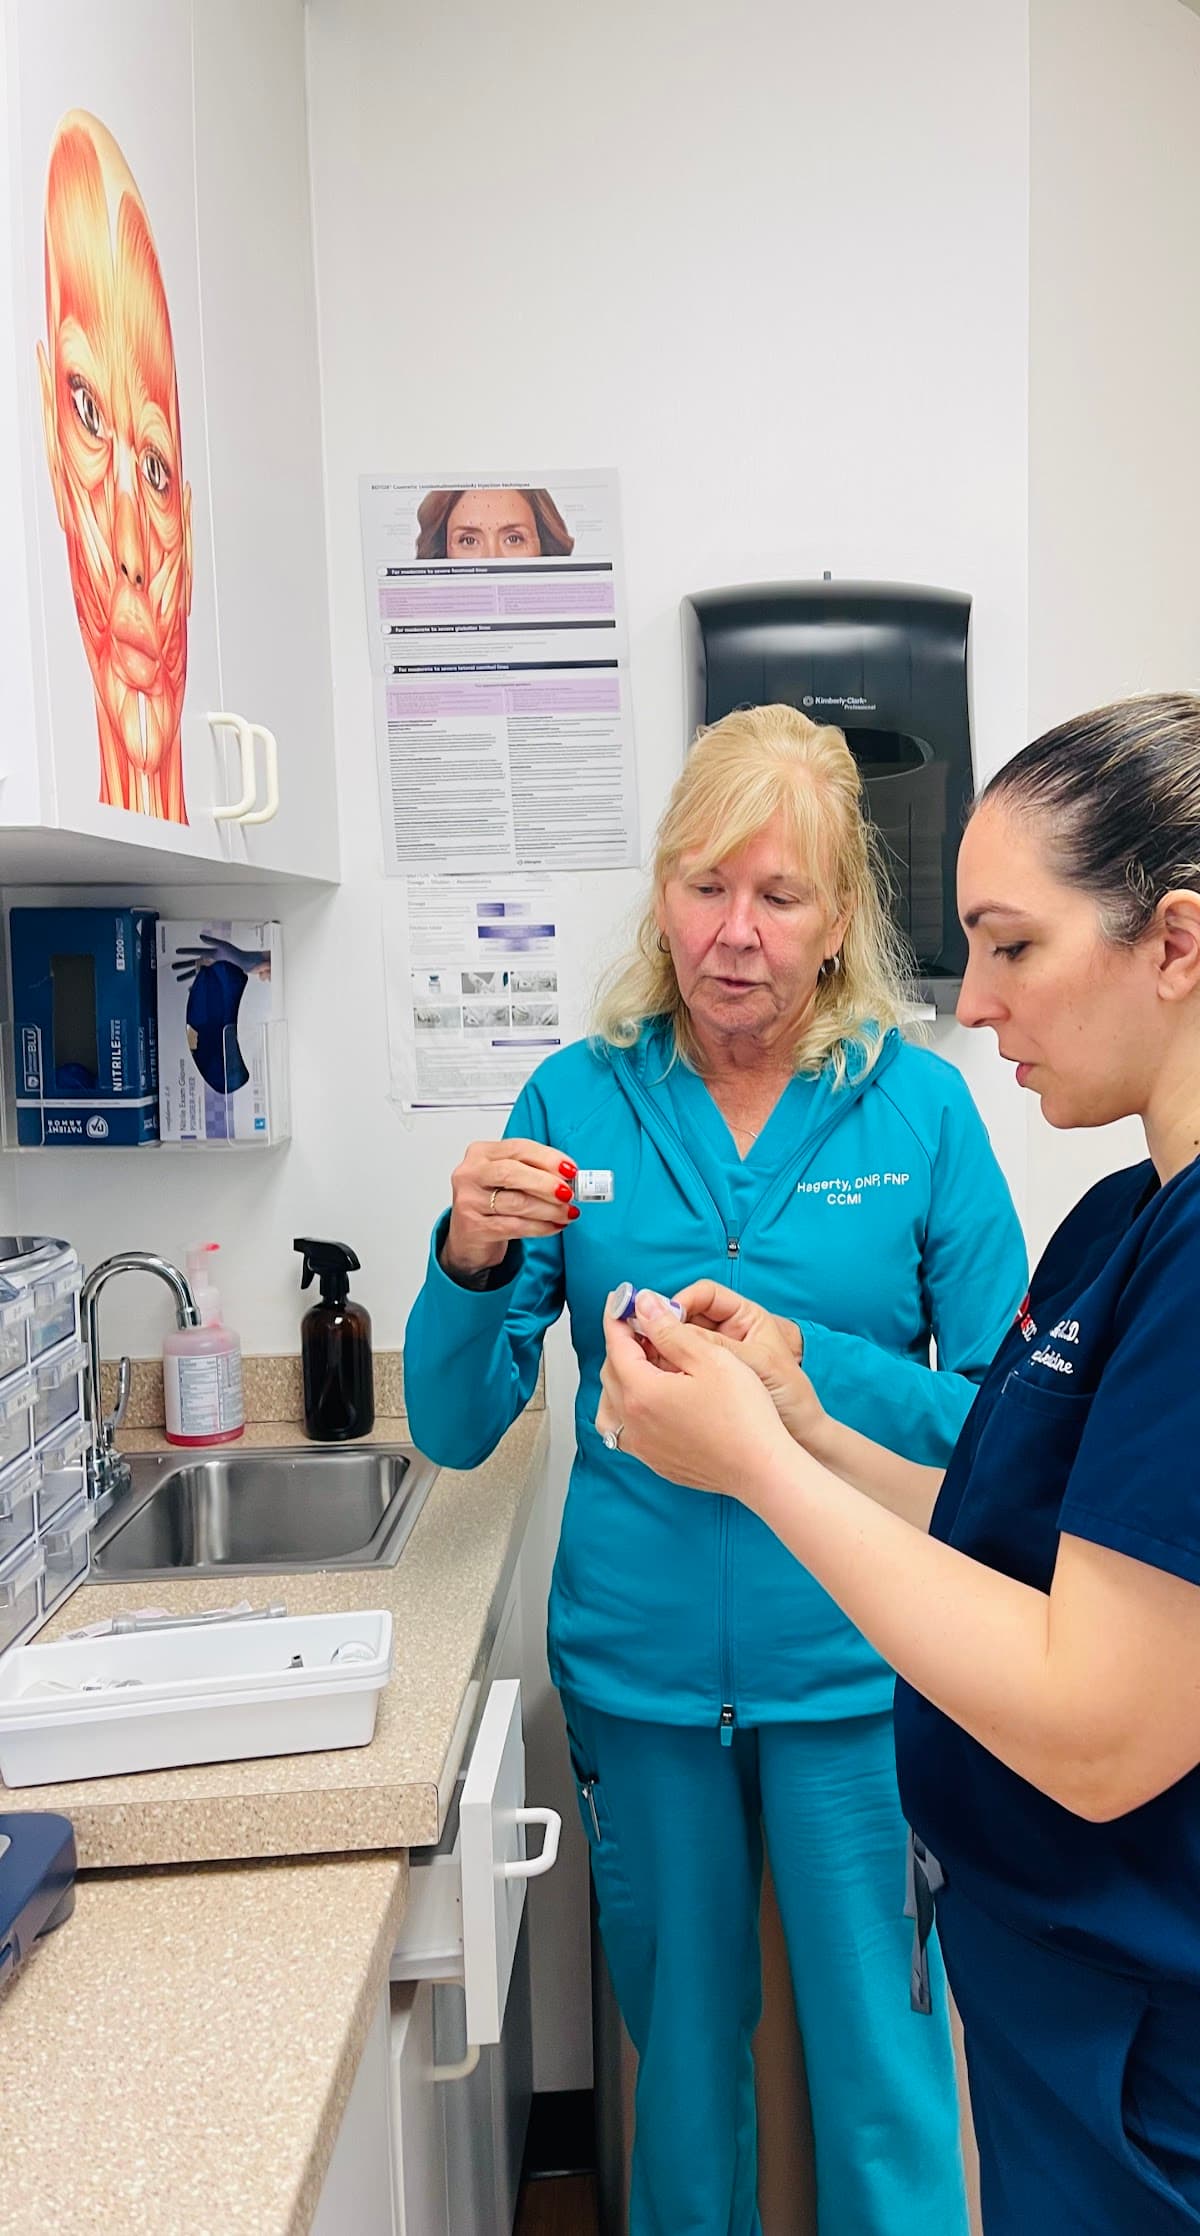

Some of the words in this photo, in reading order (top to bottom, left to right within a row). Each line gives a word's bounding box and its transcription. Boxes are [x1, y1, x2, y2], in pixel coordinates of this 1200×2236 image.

[815, 697, 864, 706] Kimberly-Clark
[116, 939, 124, 959] 200
[27, 1030, 37, 1053] BLU
[110, 1040, 123, 1092] NITRILE
[47, 1119, 81, 1127] ARMOR
[48, 1126, 82, 1134] PATIENT
[797, 1177, 852, 1192] Hagerty,
[883, 1173, 910, 1186] FNP
